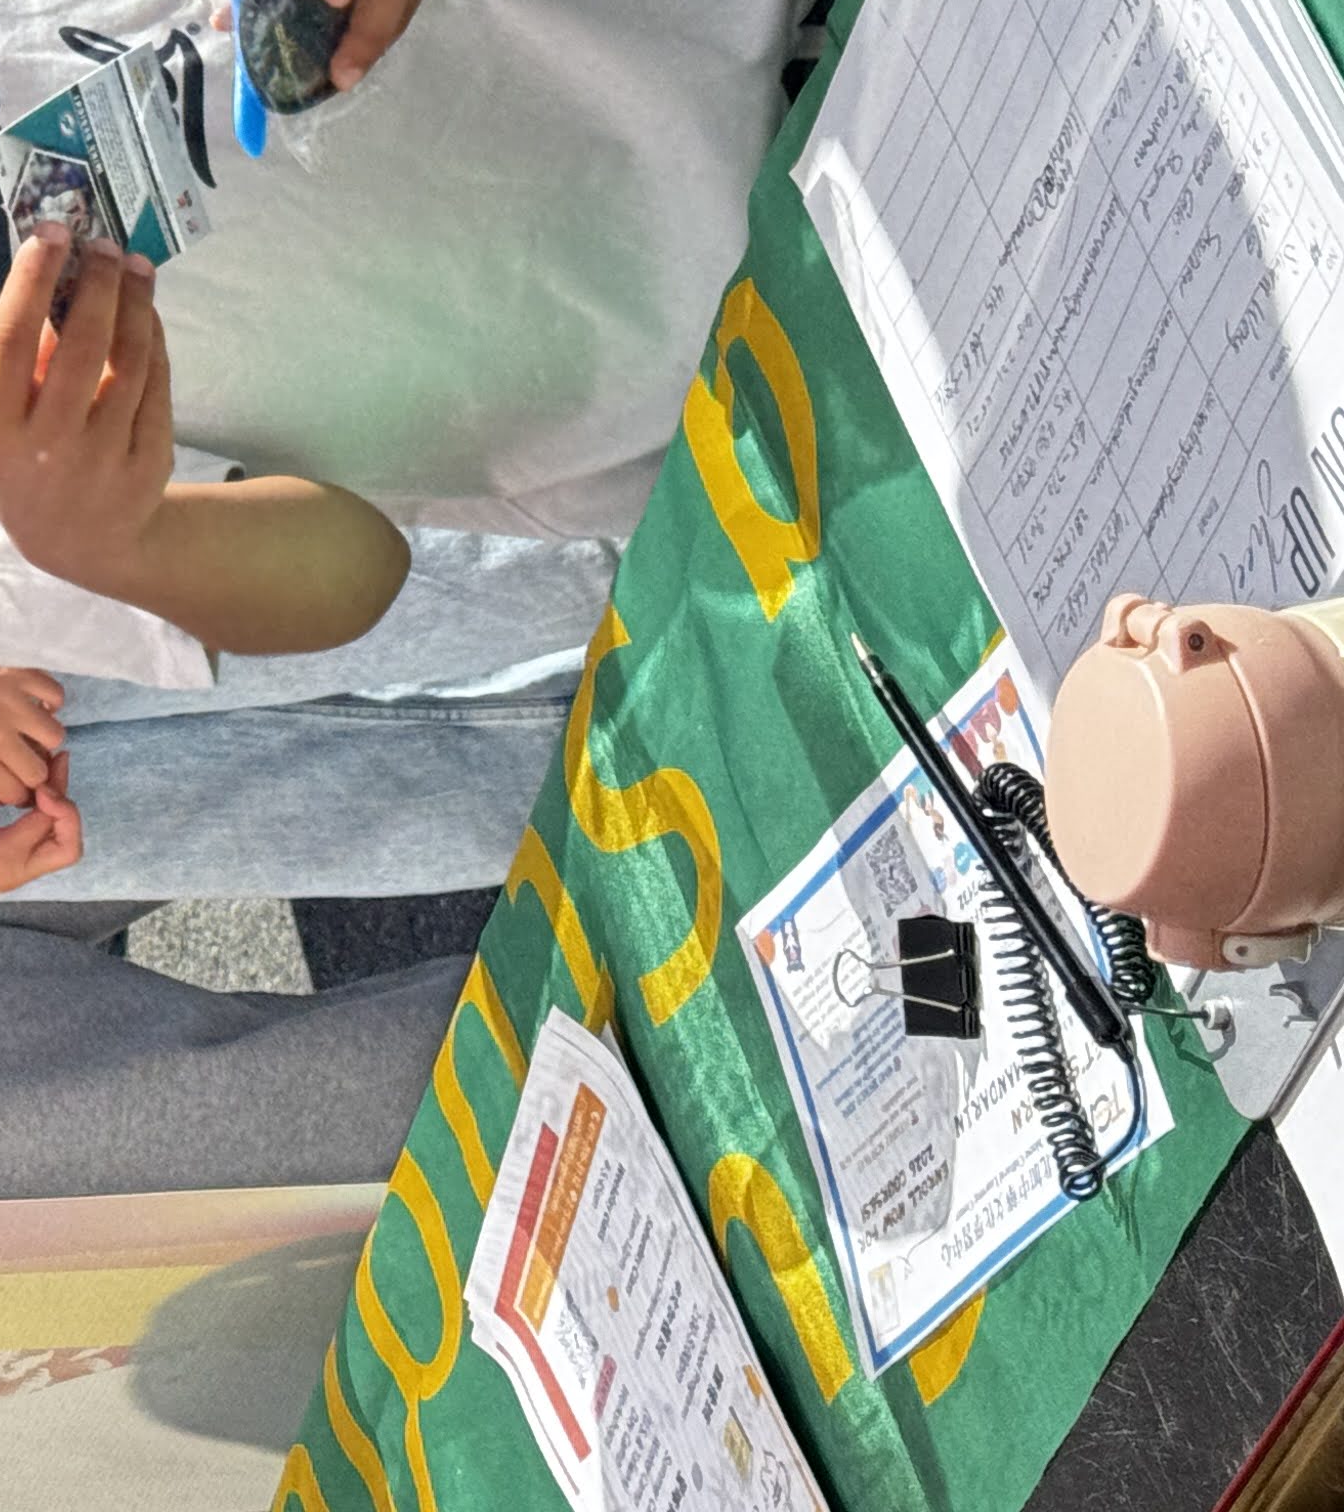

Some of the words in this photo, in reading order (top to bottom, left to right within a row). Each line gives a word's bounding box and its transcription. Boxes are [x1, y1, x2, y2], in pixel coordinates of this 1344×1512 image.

[1282, 488, 1336, 598] UP
[954, 1062, 1025, 1138] MANDARIN
[908, 1159, 949, 1209] ENROLL
